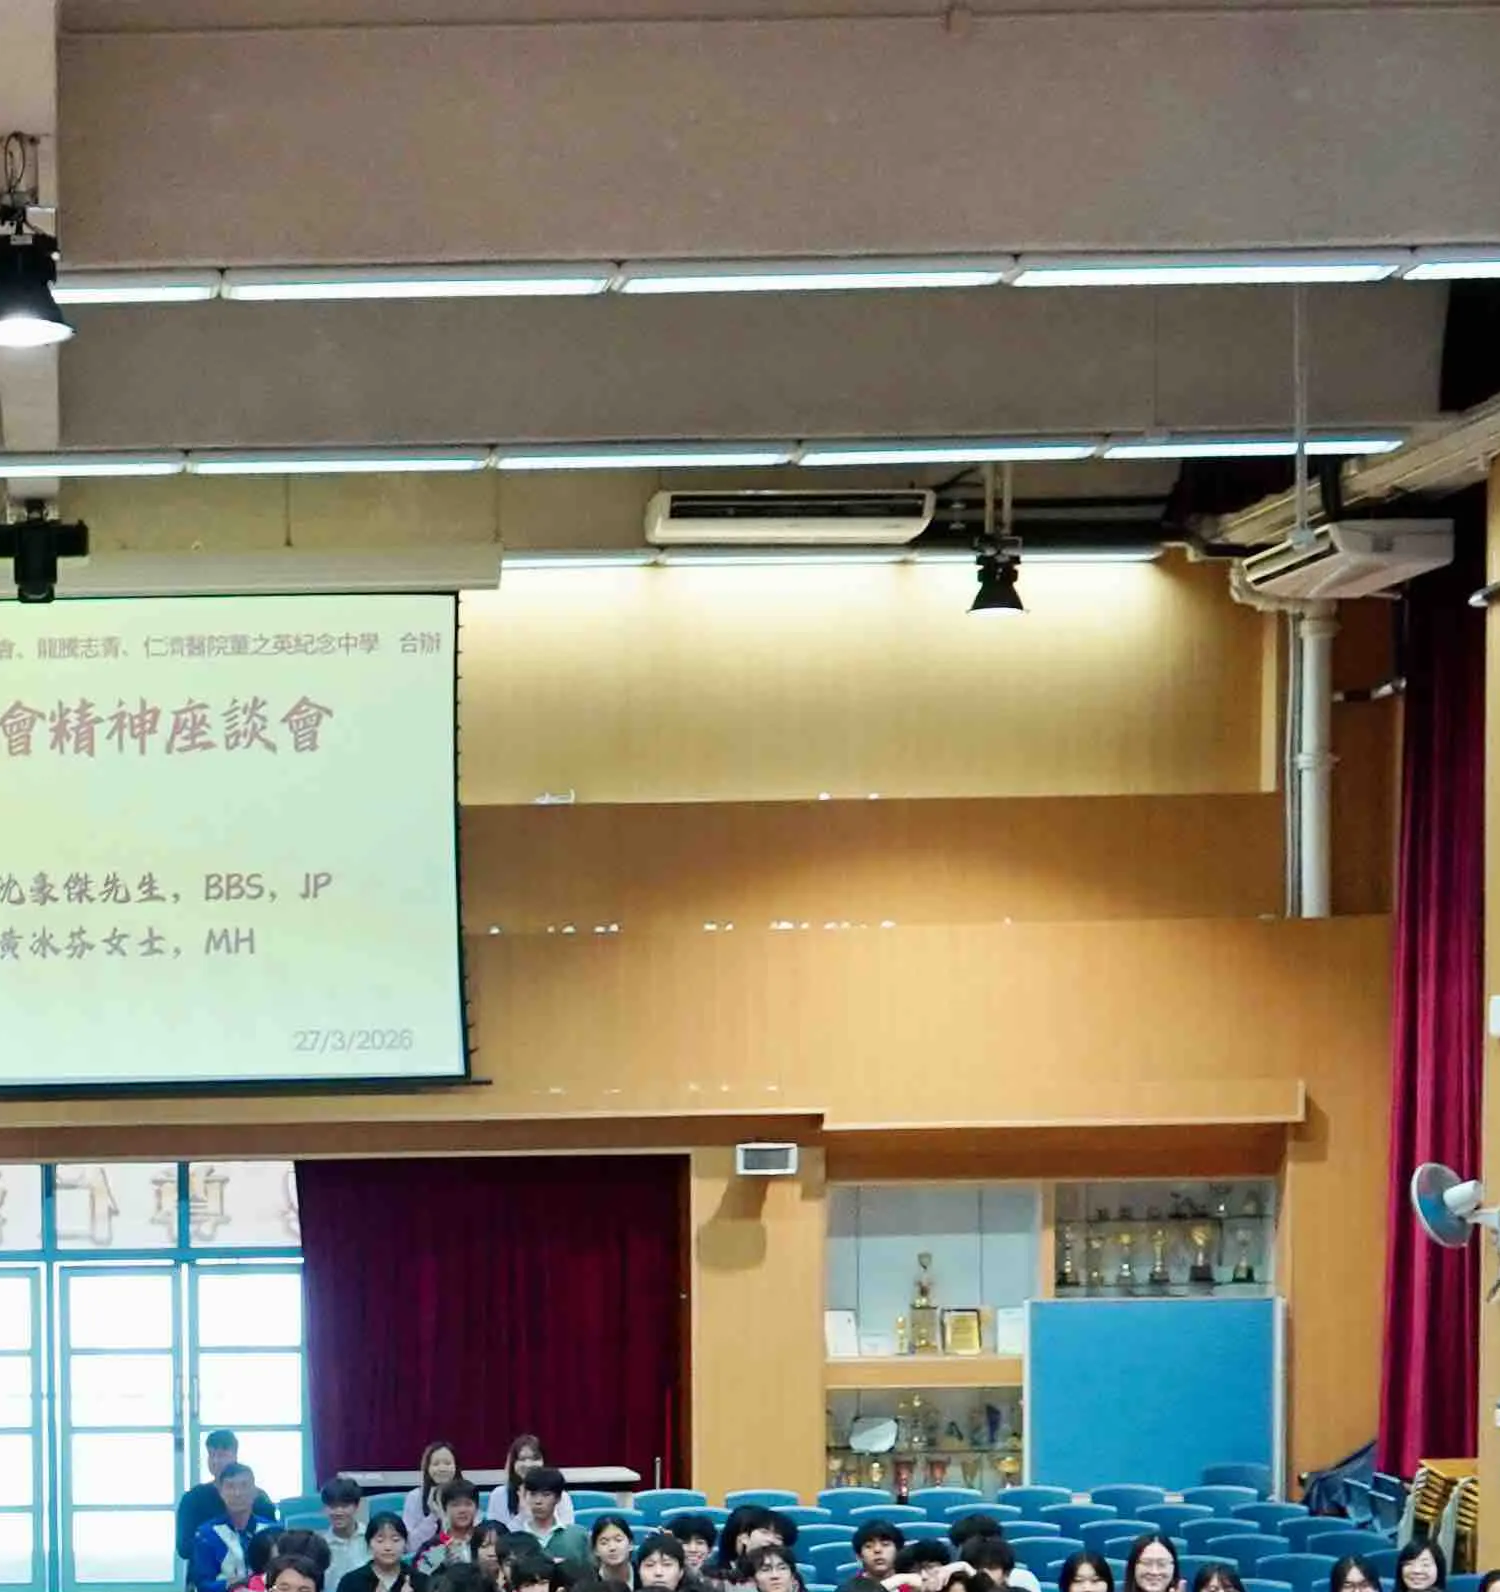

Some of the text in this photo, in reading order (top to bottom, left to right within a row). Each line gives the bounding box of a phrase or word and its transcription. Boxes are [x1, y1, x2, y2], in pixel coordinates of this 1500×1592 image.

[299, 872, 333, 899] JP
[203, 927, 257, 956] MH
[293, 1029, 415, 1052] 27/3/2026
